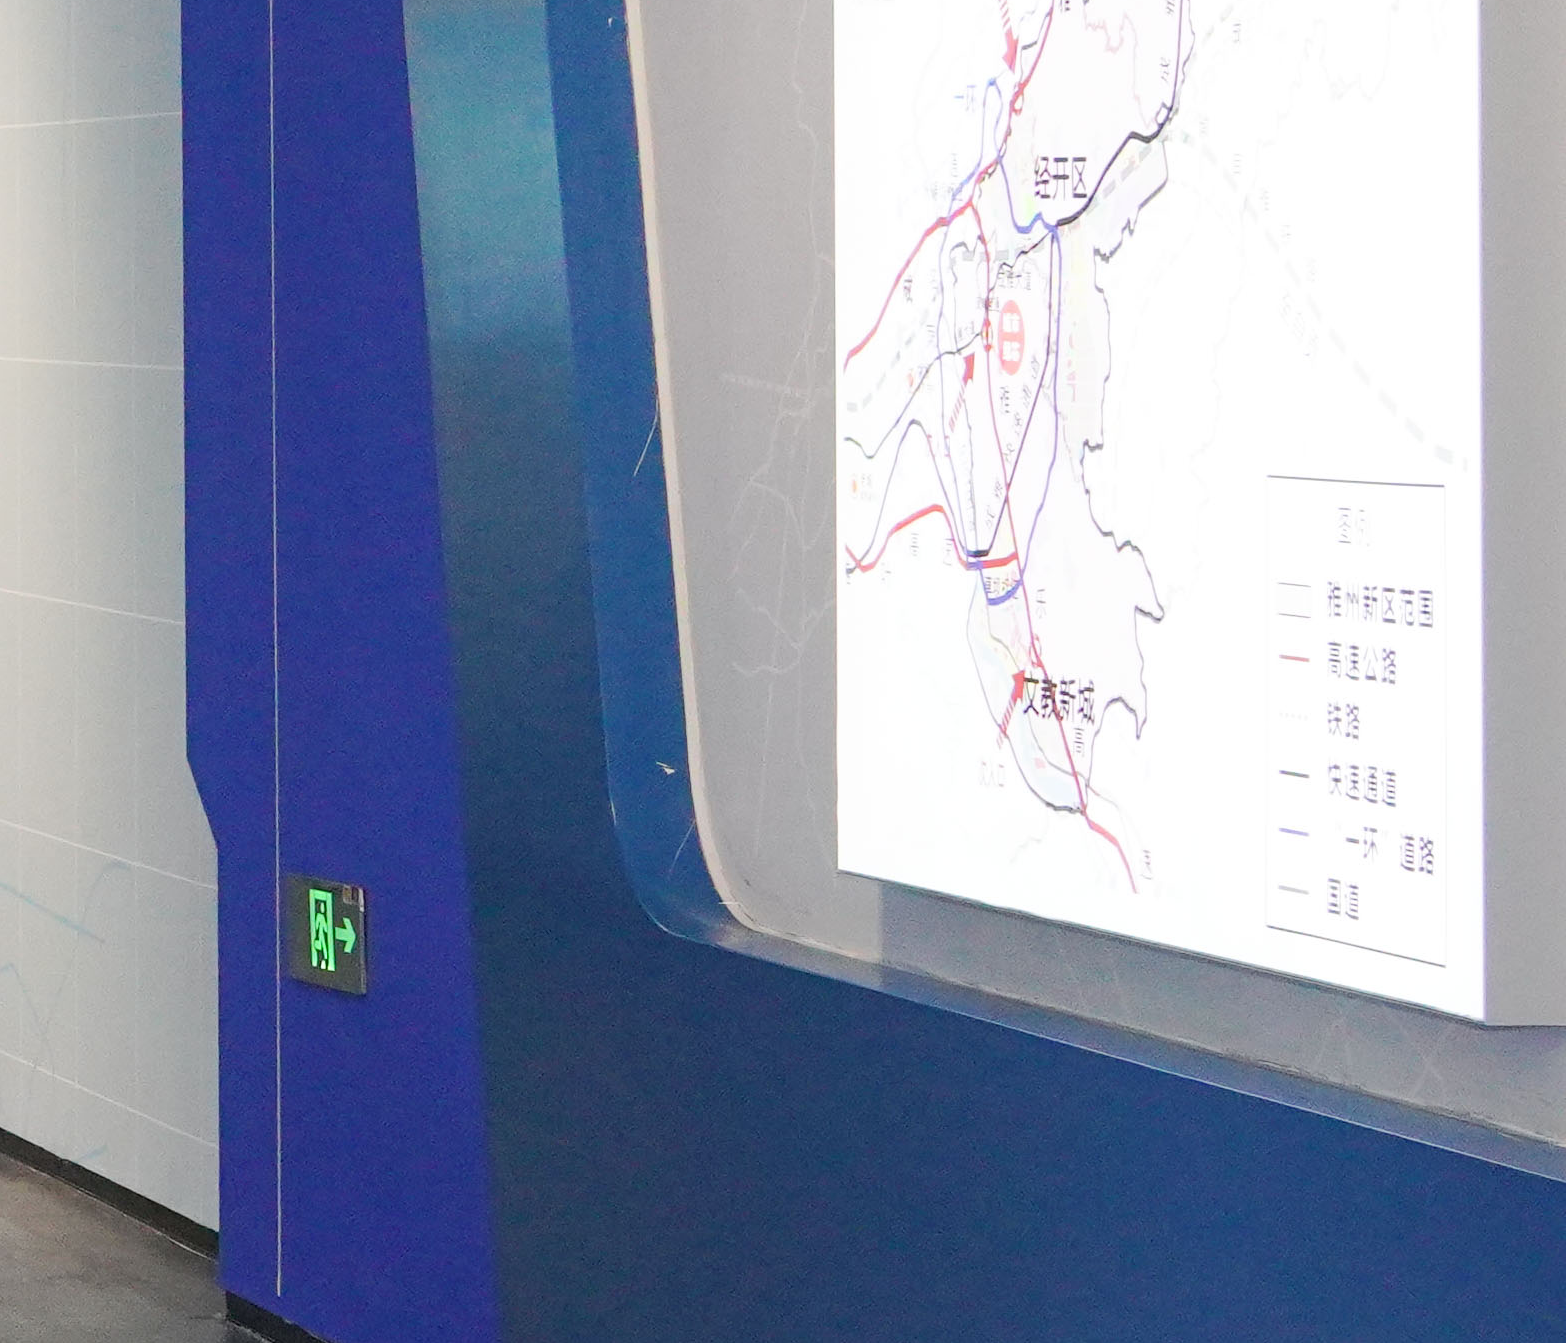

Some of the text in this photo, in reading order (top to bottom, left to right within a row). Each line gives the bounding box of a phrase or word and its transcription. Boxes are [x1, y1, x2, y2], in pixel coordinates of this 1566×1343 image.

[1034, 155, 1087, 201] 经开区
[1327, 642, 1397, 685] 高速公路
[1023, 675, 1095, 726] 文教新城
[1328, 764, 1397, 808] 快速通道
